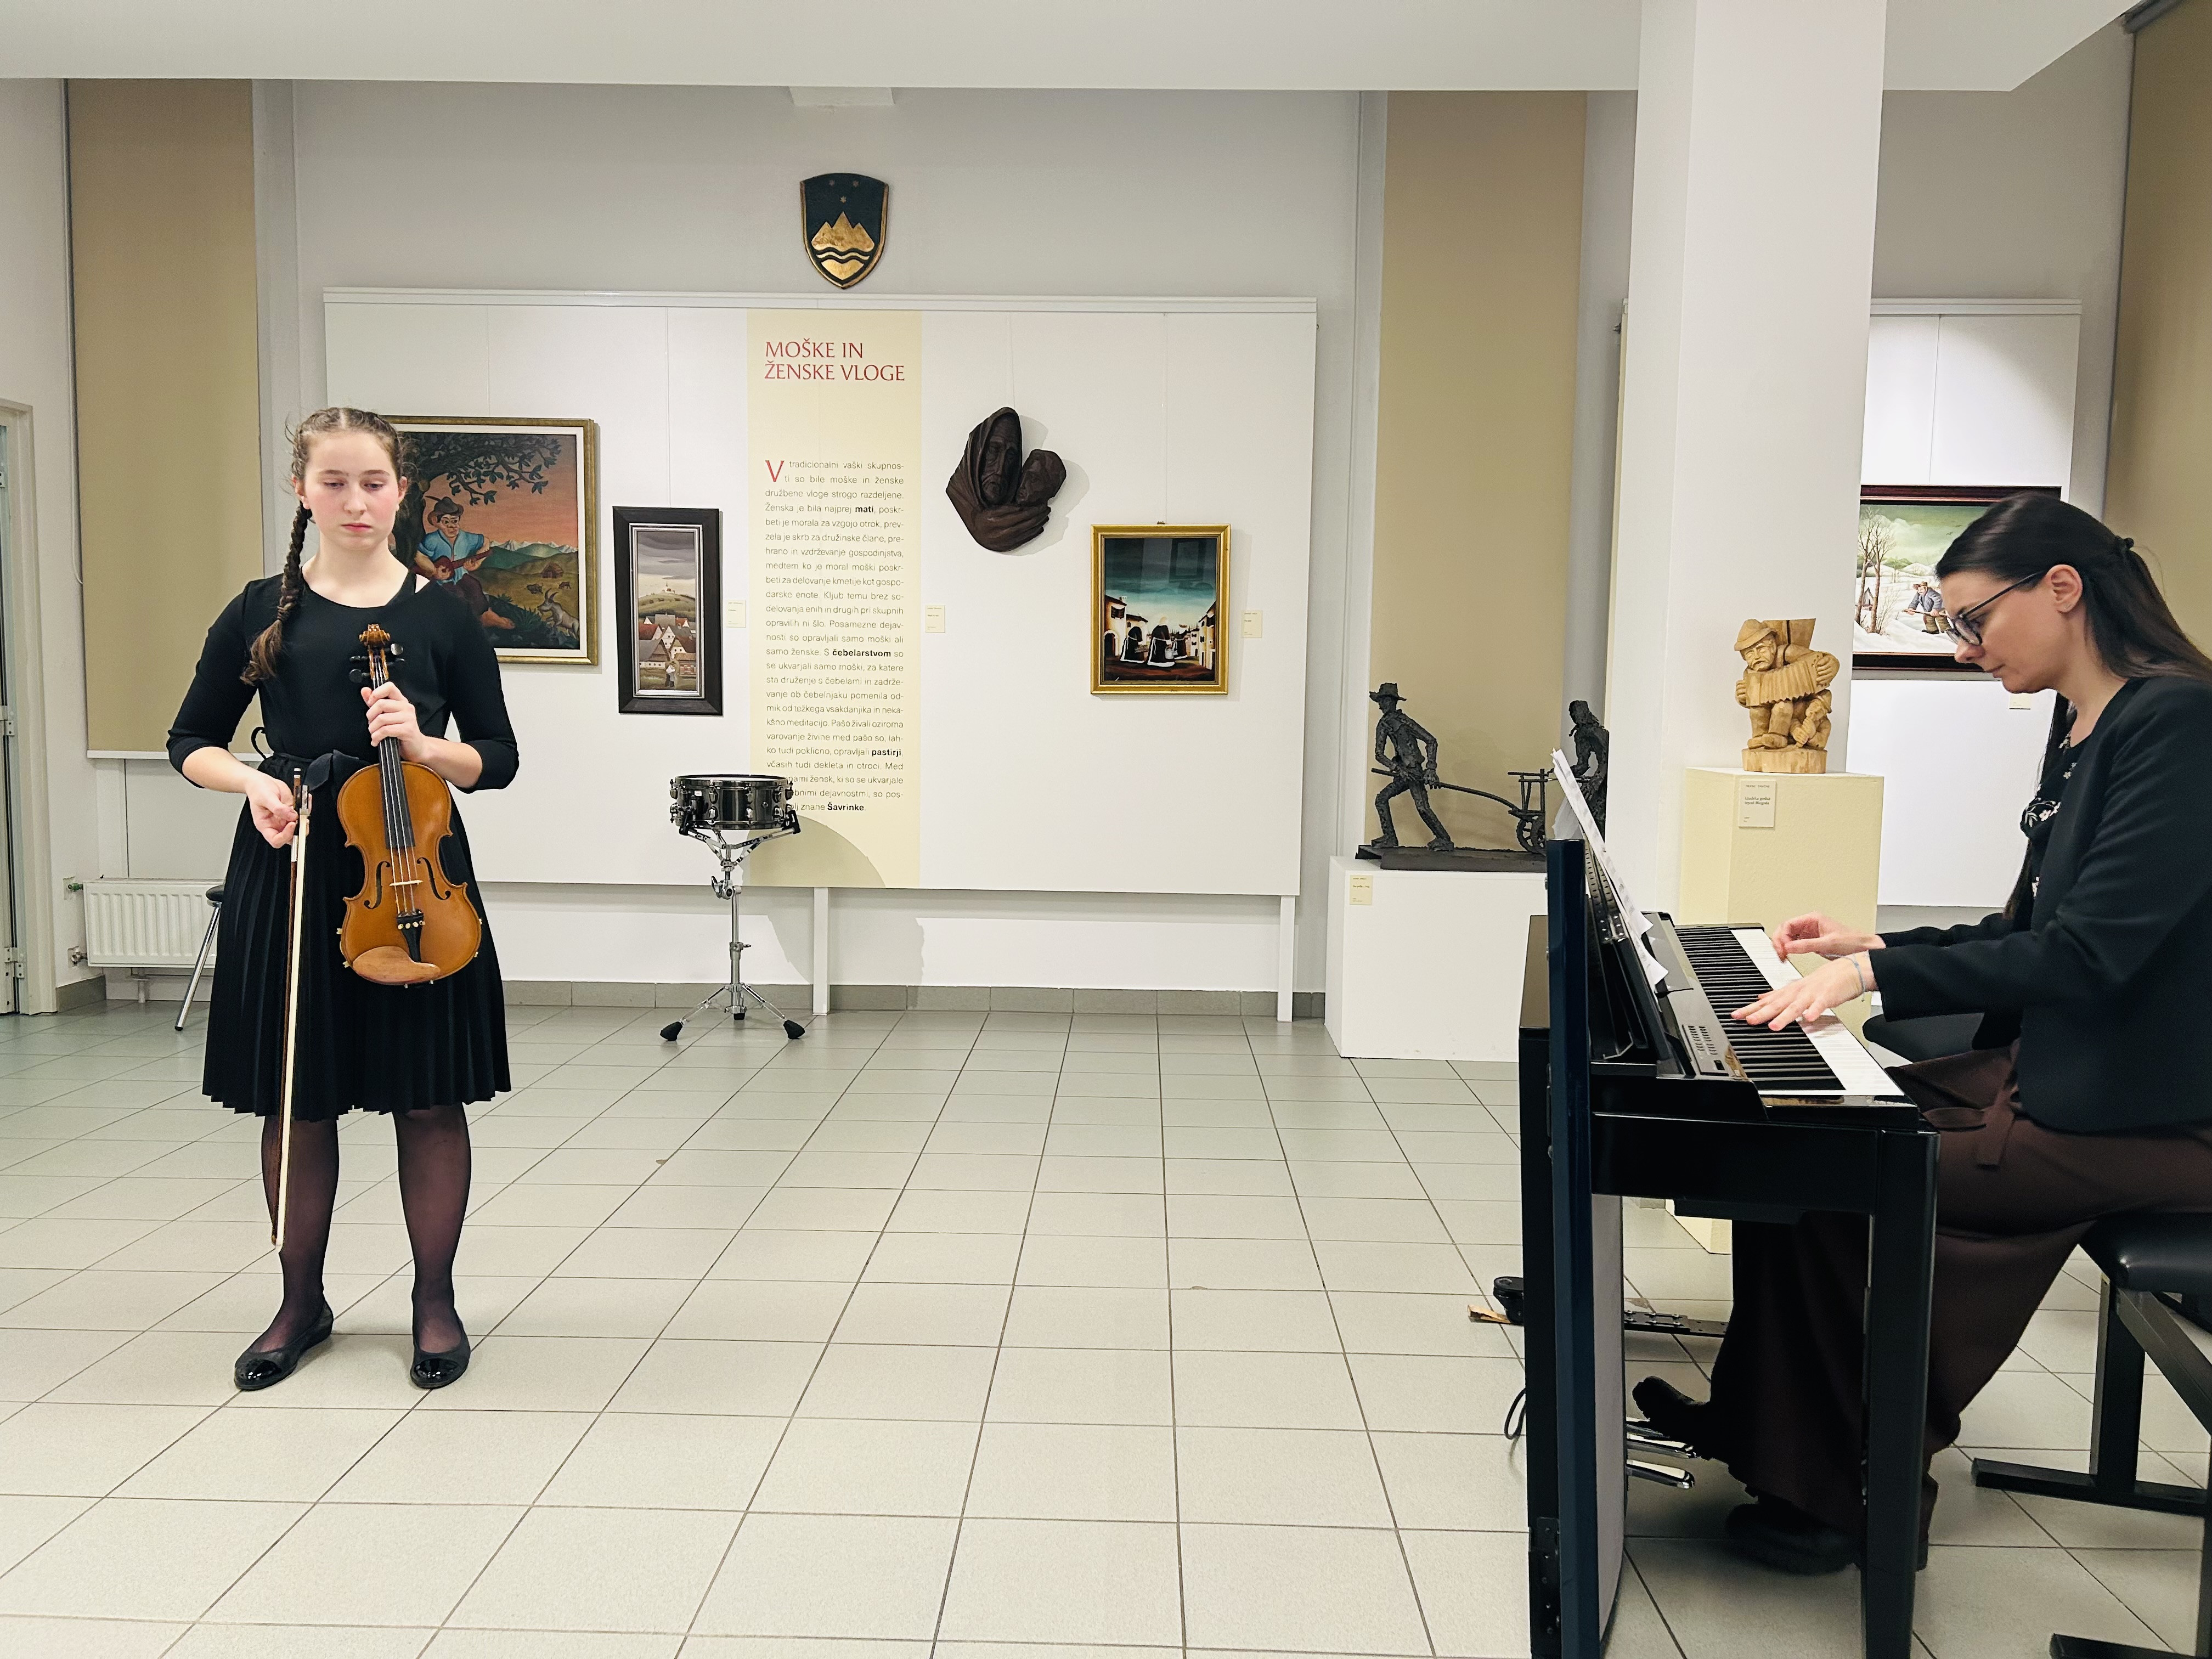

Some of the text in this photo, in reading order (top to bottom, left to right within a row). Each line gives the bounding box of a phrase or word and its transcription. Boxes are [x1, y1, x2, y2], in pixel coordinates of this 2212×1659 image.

[765, 338, 863, 358] MOŠKE IN
[764, 360, 905, 381] ŽENSKE VLOGE
[765, 460, 785, 482] V
[867, 462, 904, 471] skupnos-
[806, 490, 828, 499] vloge
[765, 502, 793, 511] Ženska
[797, 504, 804, 513] je
[825, 505, 851, 514] najprej
[879, 506, 904, 515] poskr-
[782, 518, 789, 527] je
[783, 533, 790, 541] je
[801, 548, 845, 557] vzdrževanje
[815, 563, 822, 571] je
[793, 577, 831, 585] delovanje
[833, 577, 861, 586] kmetije
[825, 591, 843, 600] Kljub
[766, 605, 803, 614] delovanja
[833, 606, 859, 615] drugih
[873, 607, 903, 616] skupnih
[766, 619, 799, 628] opravilih
[830, 620, 876, 628] Posamezne
[880, 622, 904, 630] dejav-
[803, 634, 838, 643] opravljali
[832, 648, 891, 657] čebelarstvom
[779, 662, 811, 671] ukvarjali
[781, 676, 816, 685] druženje
[804, 691, 847, 700] čebelnjaku
[794, 705, 824, 714] težkega
[826, 706, 871, 714] vsakdanjika
[766, 733, 805, 741] varovanje
[854, 734, 872, 742] pašo
[834, 748, 869, 757] opravljali
[868, 776, 903, 785] ukvarjale
